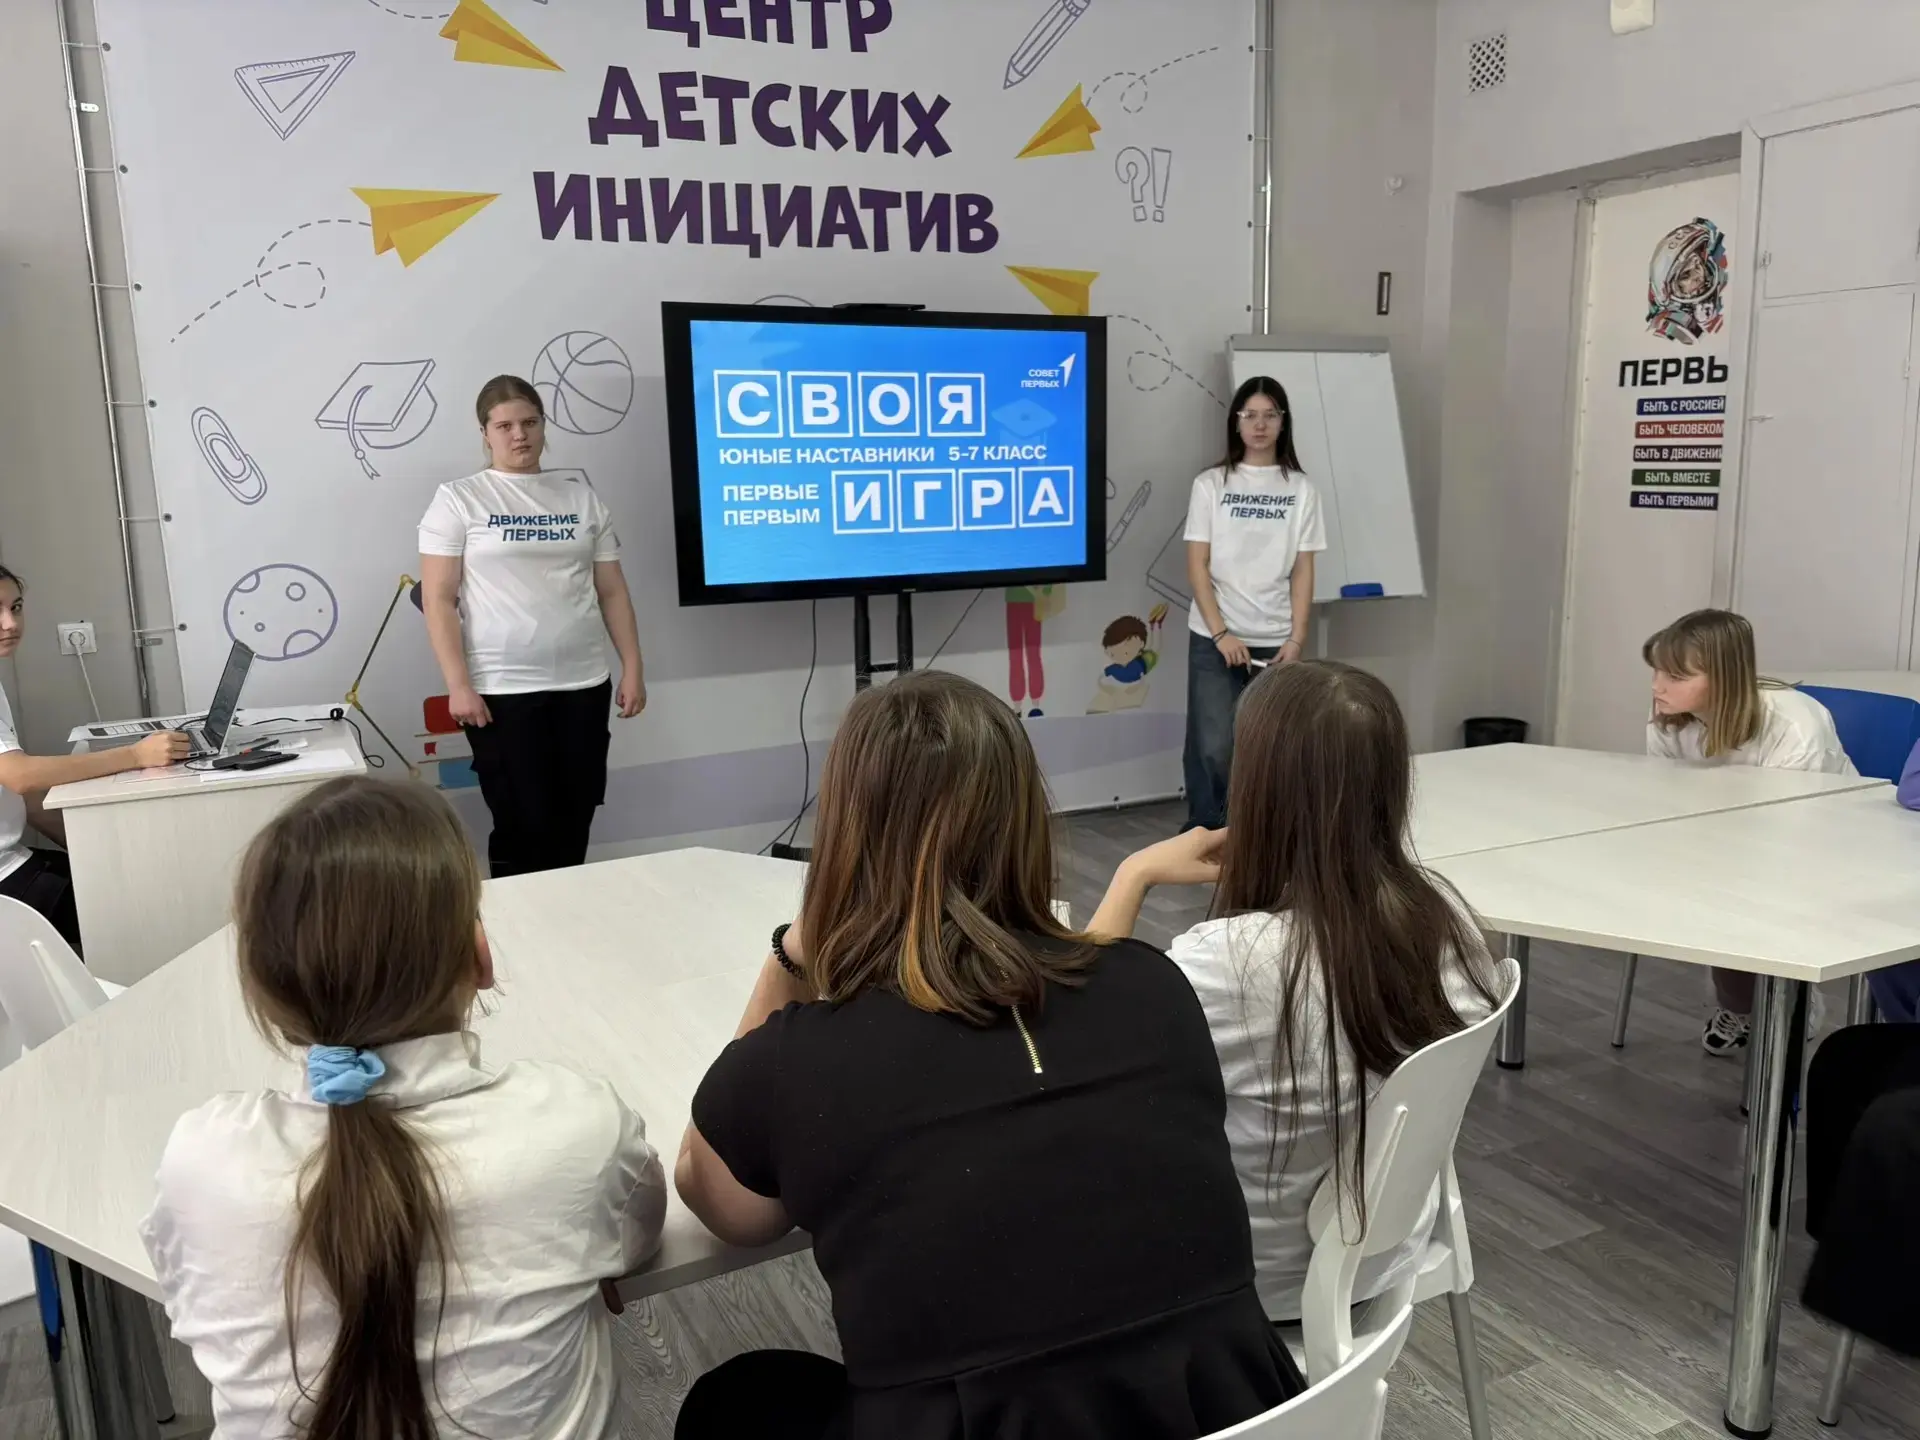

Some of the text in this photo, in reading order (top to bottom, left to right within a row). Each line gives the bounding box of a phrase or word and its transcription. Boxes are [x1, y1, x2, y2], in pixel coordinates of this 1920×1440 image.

[647, 0, 893, 53] ЦЕНТР
[588, 65, 952, 159] ДЕТСКИХ
[533, 171, 999, 259] ИНИЦИАТИВ
[1028, 369, 1060, 377] СОВЕТ
[1020, 380, 1060, 388] ПЕРВЫХ
[726, 381, 973, 426] СВОЯ
[1643, 397, 1724, 412] БЫТЬ С РОССИЕЙ
[1639, 425, 1664, 435] БЫТЬ
[719, 445, 1047, 465] ЮНЫЕ НАСТАВНИКИ 5-7 КЛАСС
[1635, 448, 1660, 459] БЫТЬ
[1662, 449, 1669, 459] В
[1645, 472, 1711, 483] БЫТЬ ВМЕСТЕ
[722, 484, 819, 502] ПЕРВЫЕ
[843, 477, 1064, 522] ИГРА
[1220, 493, 1296, 506] ДВИЖЕНИЕ
[1638, 495, 1714, 507] БЫТЬ ПЕРВЫМИ
[723, 508, 820, 526] ПЕРВЫМ
[1230, 507, 1287, 519] ПЕРВЫХ
[488, 514, 580, 528] ДВИЖЕНИЕ
[503, 528, 576, 541] ПЕРВЫХ
